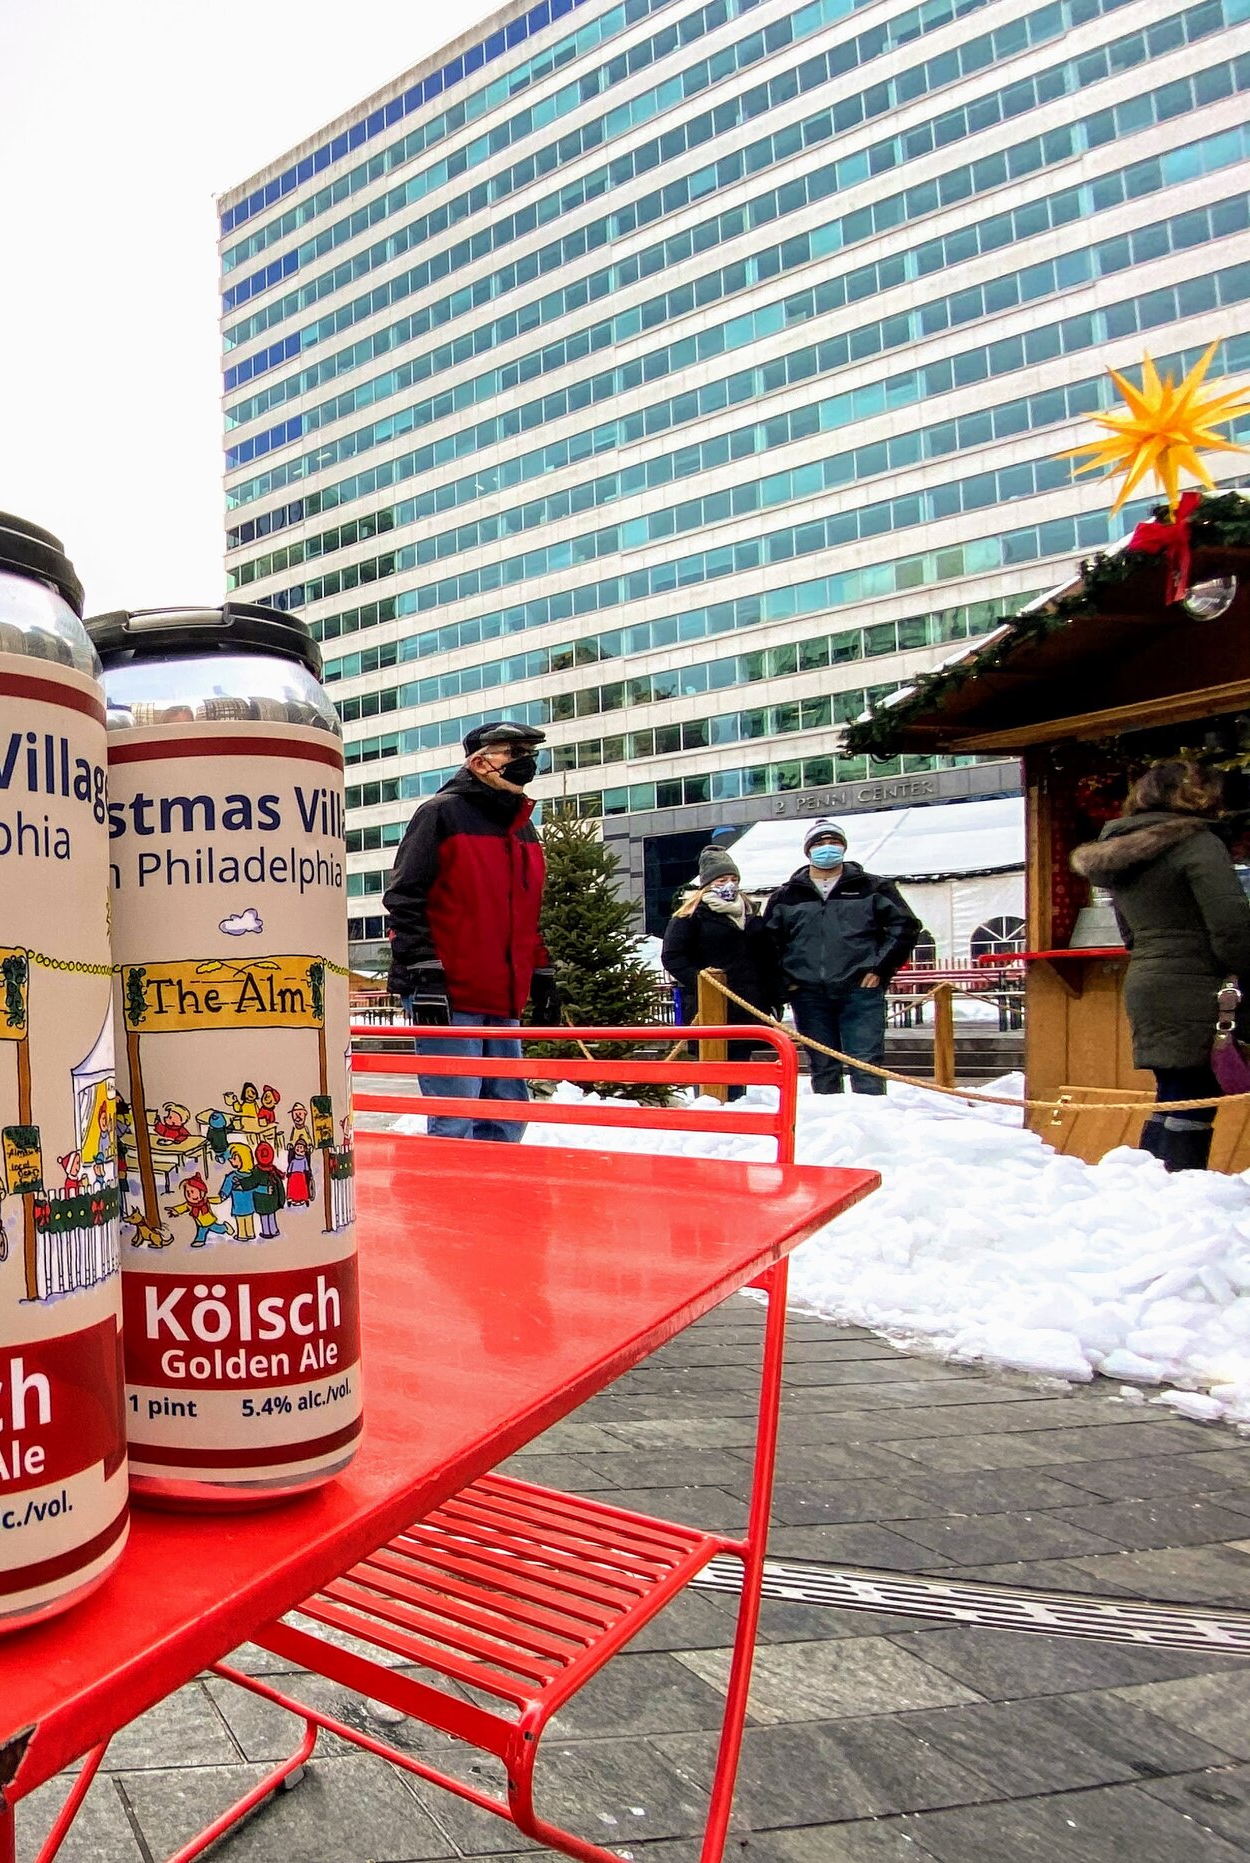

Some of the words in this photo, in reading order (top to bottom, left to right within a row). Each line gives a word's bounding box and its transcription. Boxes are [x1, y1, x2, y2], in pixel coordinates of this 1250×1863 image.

[109, 792, 281, 838] stmas
[775, 802, 785, 814] 2
[796, 792, 846, 811] PENN
[857, 781, 934, 802] CENTER
[138, 847, 343, 894] Philadelphia
[146, 978, 223, 1015] The
[236, 972, 307, 1013] Alm
[145, 1275, 341, 1343] Kölsch
[161, 1348, 290, 1379] Golden
[299, 1338, 338, 1373] Ale
[129, 1394, 139, 1412] 1
[148, 1397, 198, 1419] pint
[241, 1395, 292, 1417] 5.4%
[298, 1377, 352, 1411] alc./vol.
